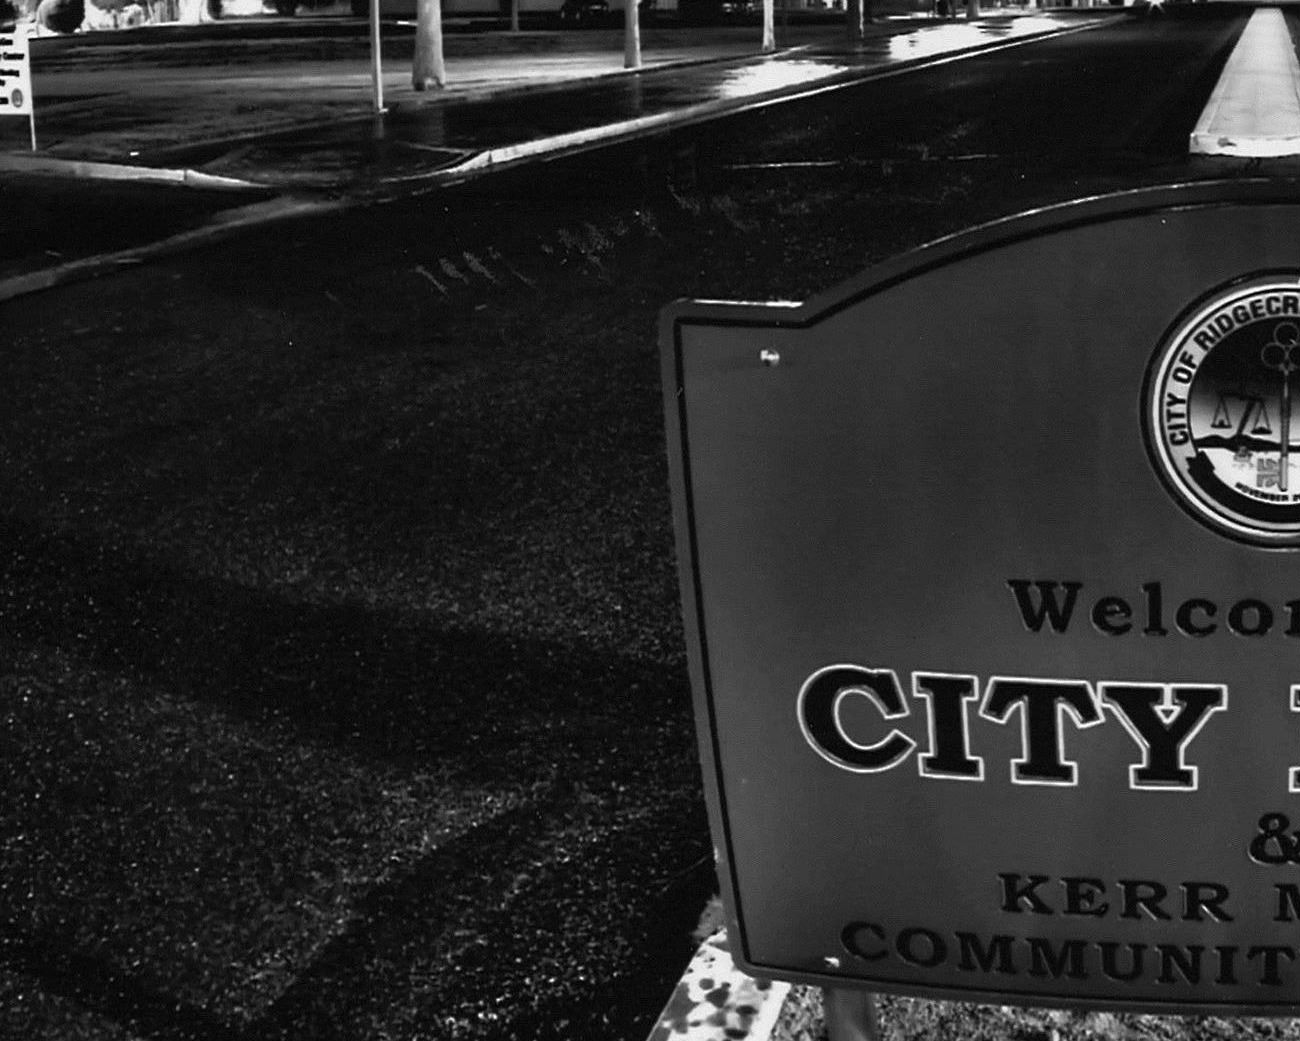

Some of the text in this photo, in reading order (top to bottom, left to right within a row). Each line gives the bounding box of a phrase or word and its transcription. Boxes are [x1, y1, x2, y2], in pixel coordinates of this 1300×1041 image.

[1172, 351, 1199, 386] OF
[1166, 392, 1190, 446] CITY
[797, 664, 1229, 791] CITY
[997, 873, 1234, 922] KERR
